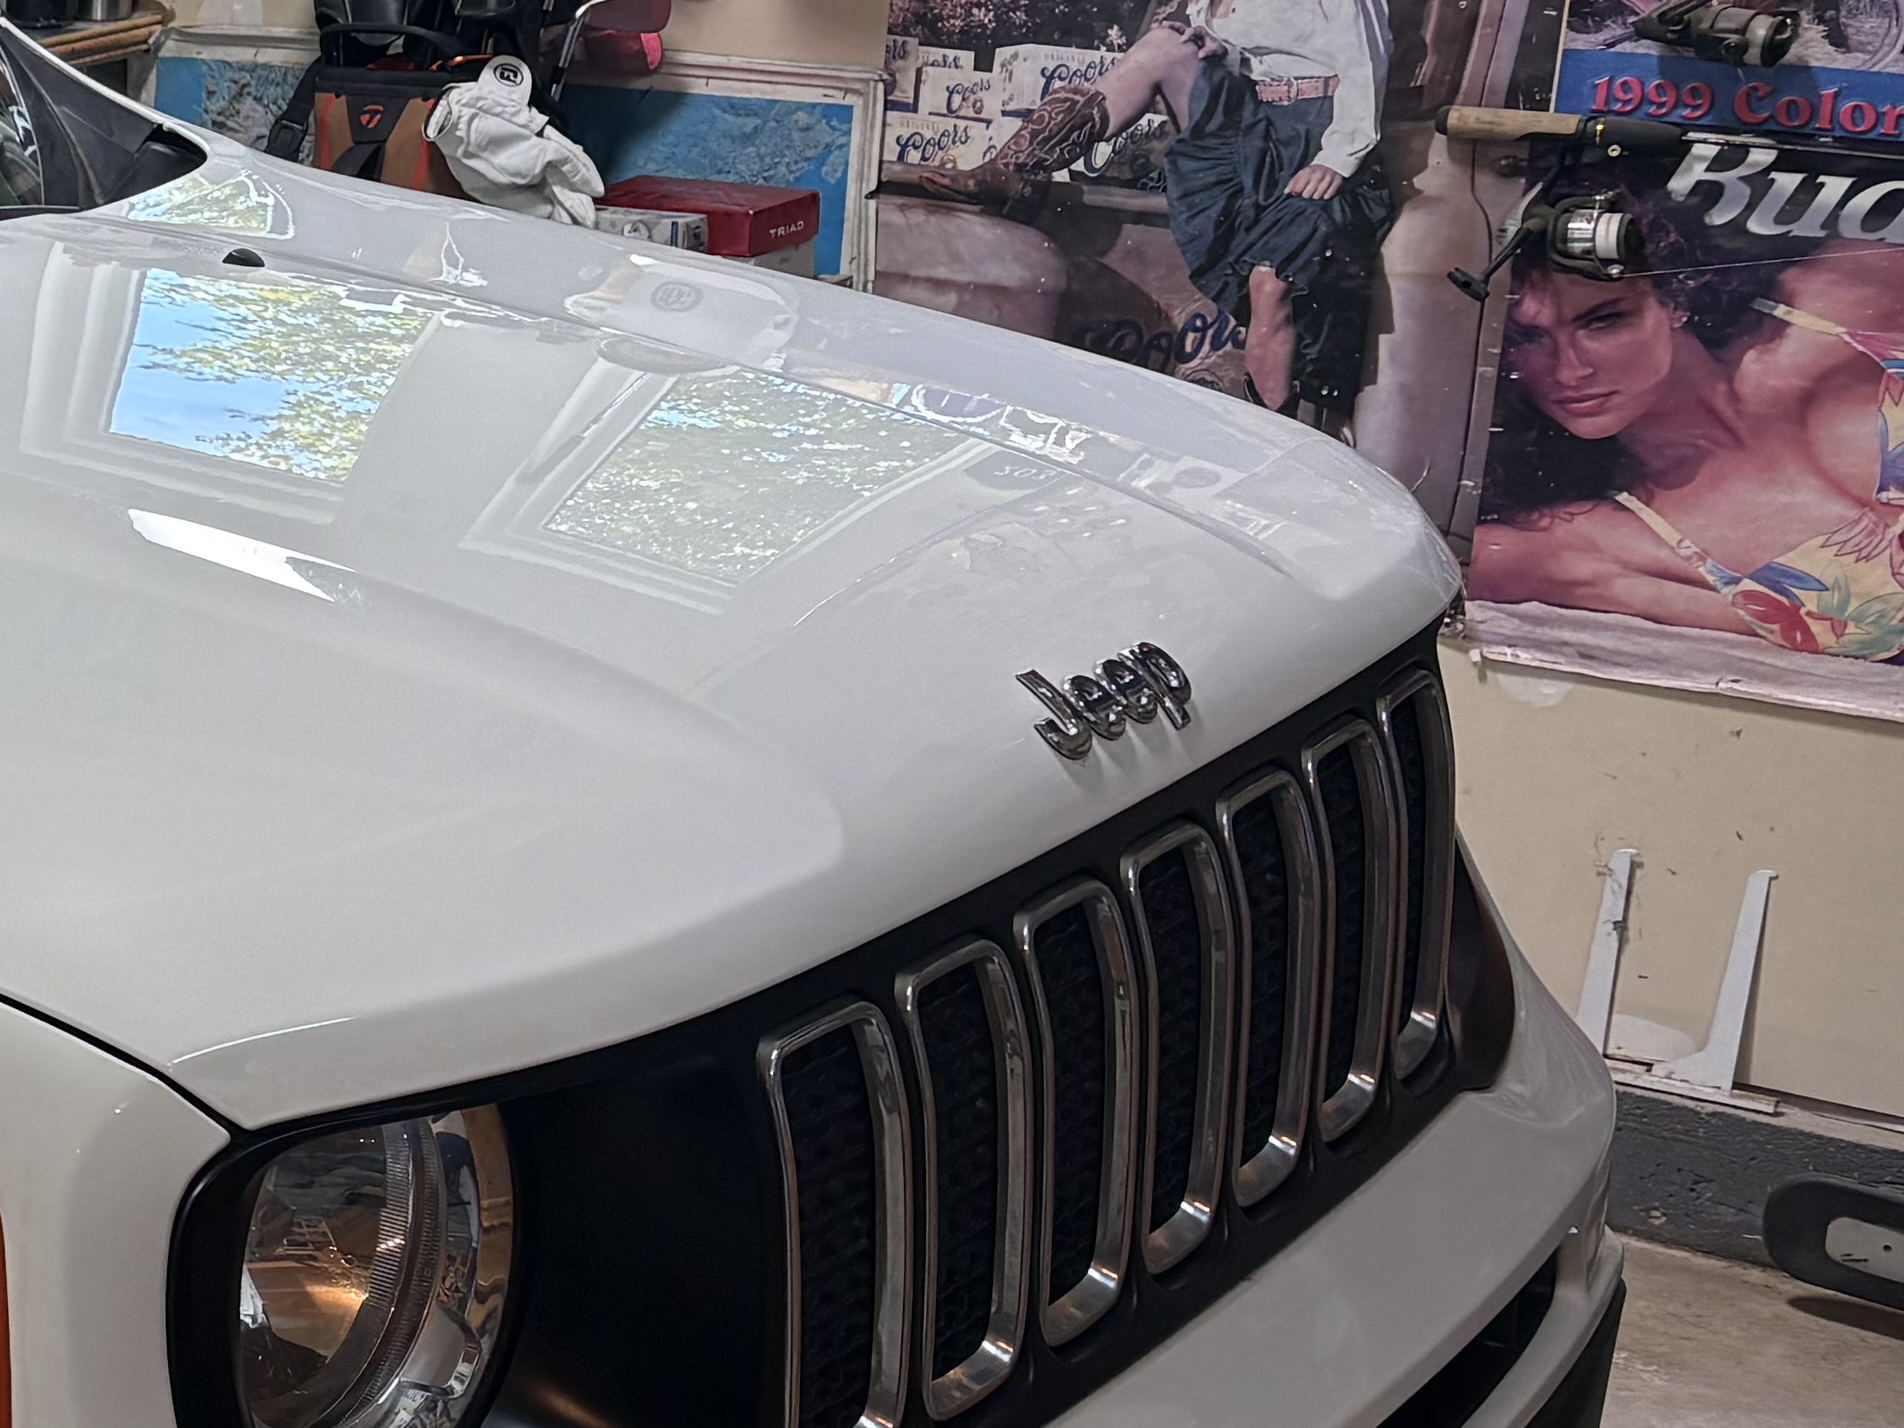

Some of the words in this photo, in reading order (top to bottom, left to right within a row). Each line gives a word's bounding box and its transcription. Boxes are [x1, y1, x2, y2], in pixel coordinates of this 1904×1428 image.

[946, 79, 991, 115] Coors
[1592, 76, 1714, 121] 1999
[895, 123, 971, 165] Coors
[769, 221, 805, 238] TRIAD
[1016, 642, 1191, 760] Jeep
